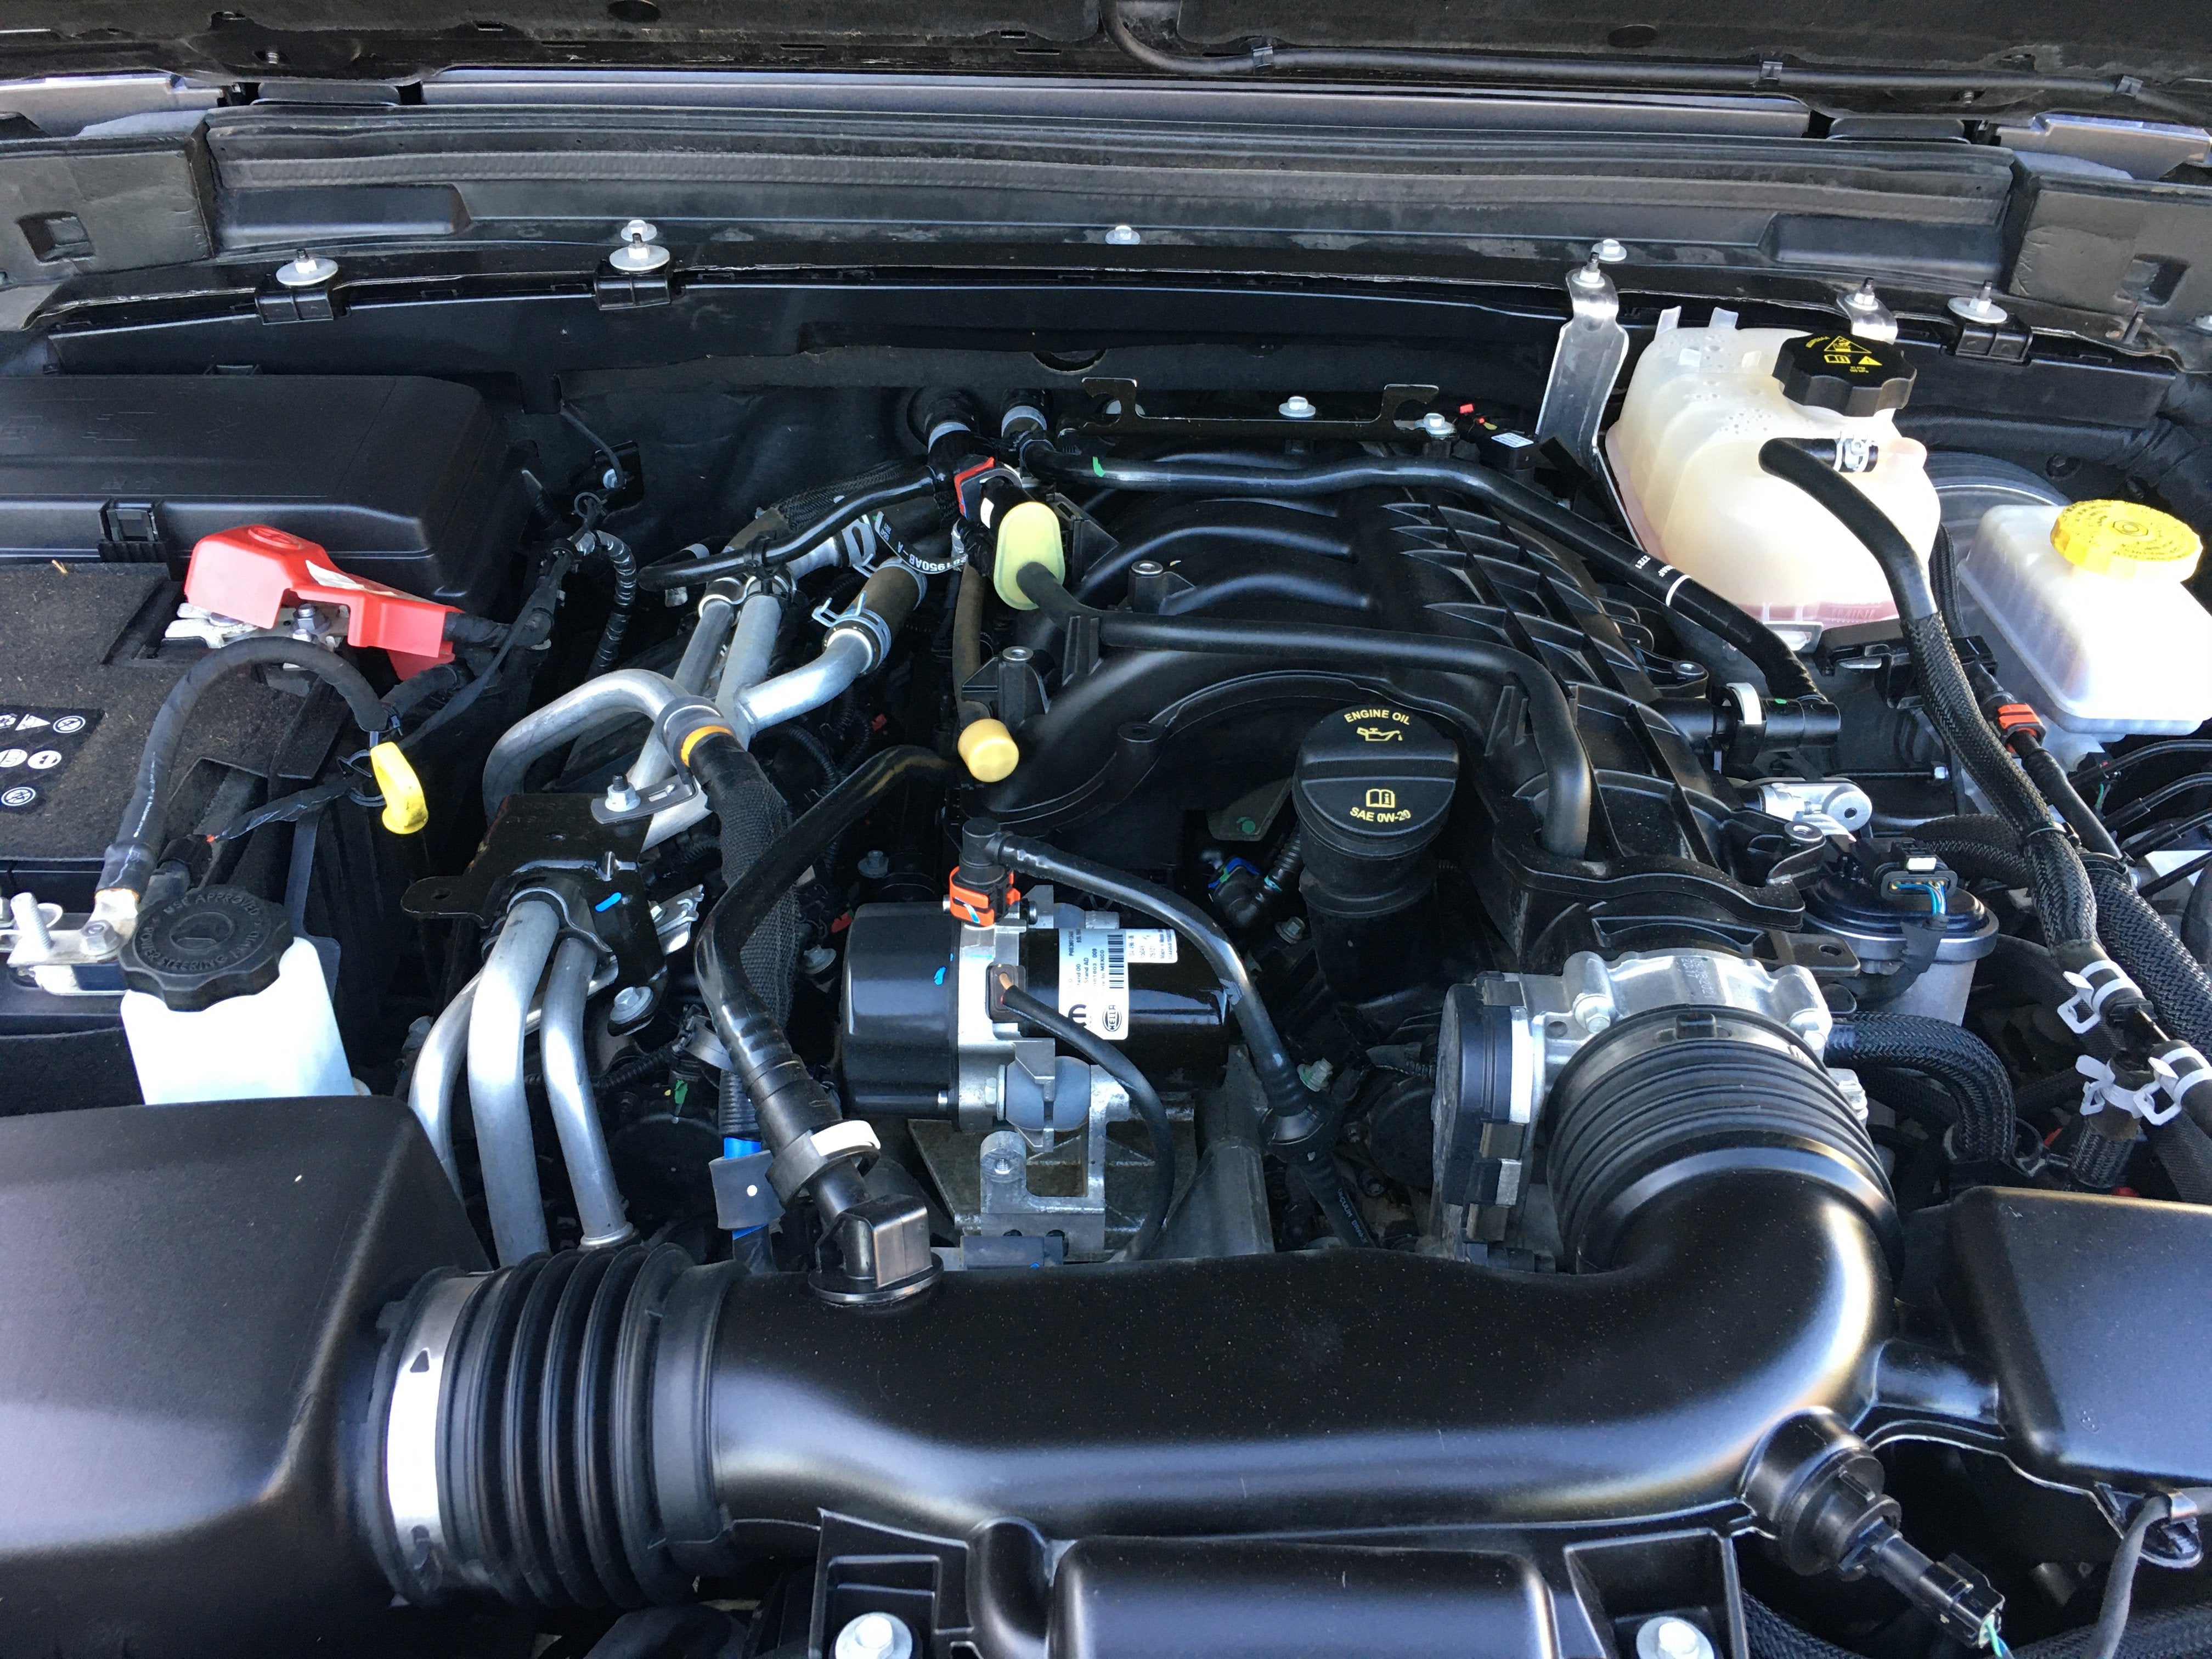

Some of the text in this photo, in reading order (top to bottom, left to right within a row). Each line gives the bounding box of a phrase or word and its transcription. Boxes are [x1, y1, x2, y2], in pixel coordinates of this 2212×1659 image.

[1344, 709, 1410, 725] ENGINE OIL
[1350, 807, 1412, 823] SAE 0W-20
[163, 893, 261, 916] USE APPROVED
[140, 926, 161, 962] POWER
[156, 955, 228, 972] STEERING
[1084, 957, 1089, 966] AD
